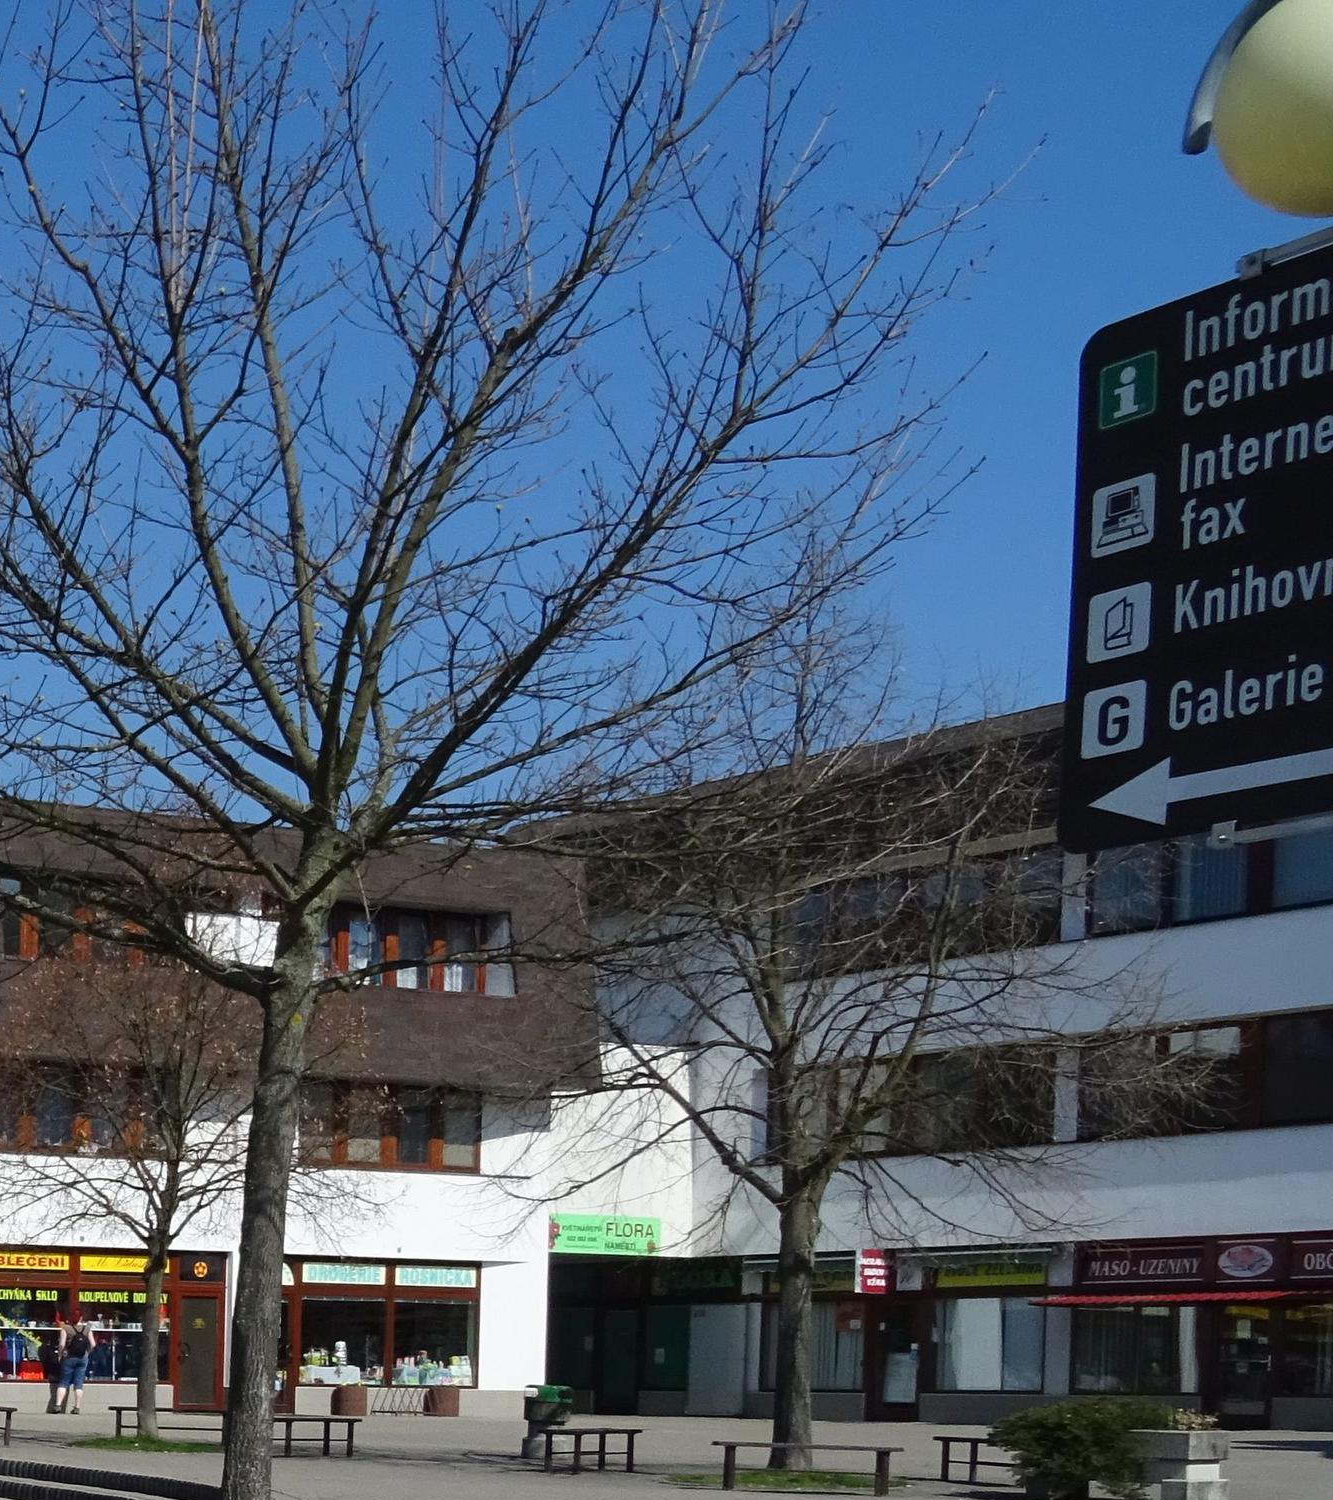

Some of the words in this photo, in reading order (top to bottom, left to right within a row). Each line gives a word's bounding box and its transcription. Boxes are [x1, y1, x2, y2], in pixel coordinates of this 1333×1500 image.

[1184, 278, 1331, 362] Inform
[1183, 335, 1333, 417] centru
[1179, 414, 1333, 493] Interne
[1181, 498, 1246, 550] fax
[1097, 695, 1131, 747] G
[1168, 653, 1324, 731] Galerie
[605, 1222, 655, 1239] FLORA
[35, 1289, 58, 1302] SKLO
